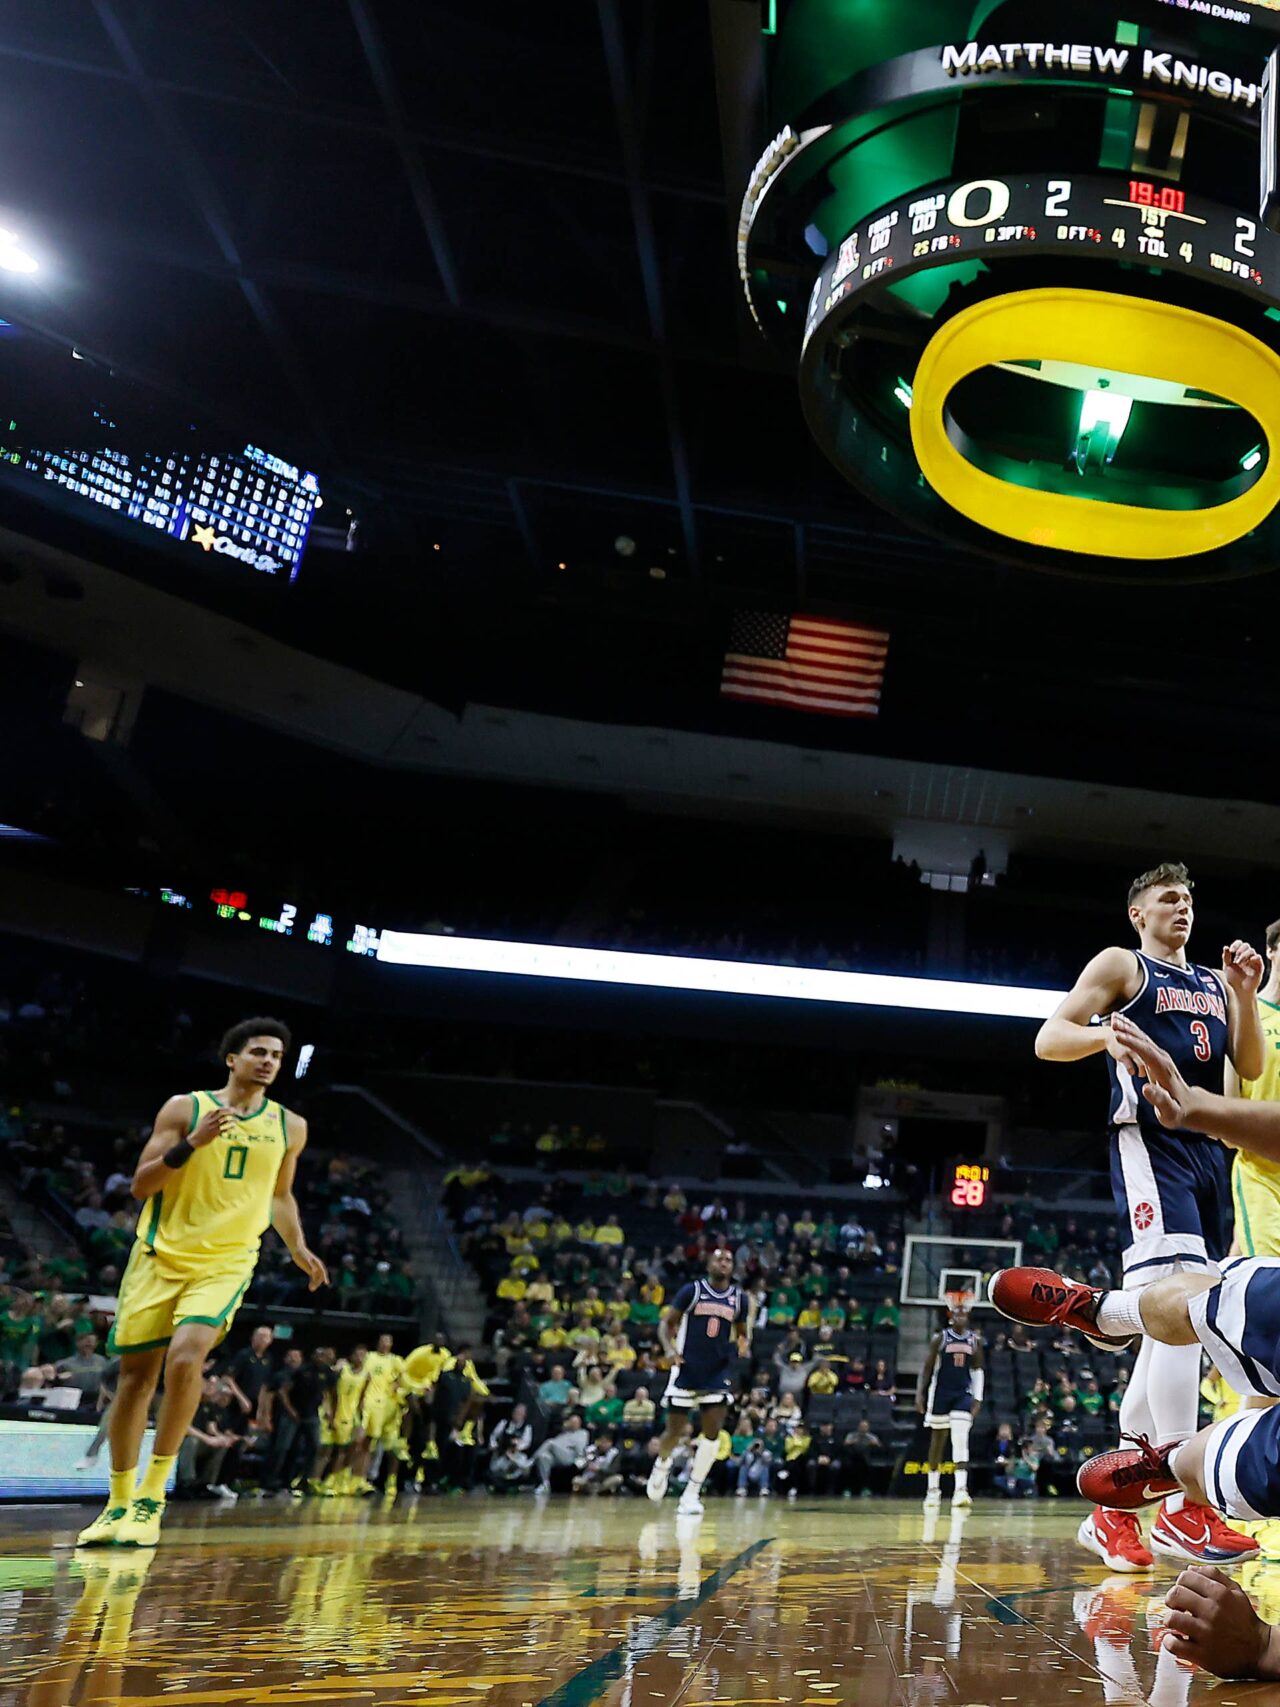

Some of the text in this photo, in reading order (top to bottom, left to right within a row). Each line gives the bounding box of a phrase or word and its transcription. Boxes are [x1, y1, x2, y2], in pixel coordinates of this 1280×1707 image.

[942, 42, 1263, 105] MATTHEW KNIGH
[947, 179, 1010, 228] O
[1044, 180, 1072, 217] 2
[1129, 181, 1186, 213] 19:01
[1140, 208, 1170, 228] 1ST
[1111, 228, 1193, 263] 4 TOL 4
[1234, 216, 1256, 257] 2
[279, 903, 298, 927] 2
[1155, 986, 1227, 1026] ARIZONA
[1190, 1020, 1212, 1062] 3
[223, 1146, 248, 1179] 0
[951, 1178, 984, 1206] 28
[706, 1316, 720, 1338] 0
